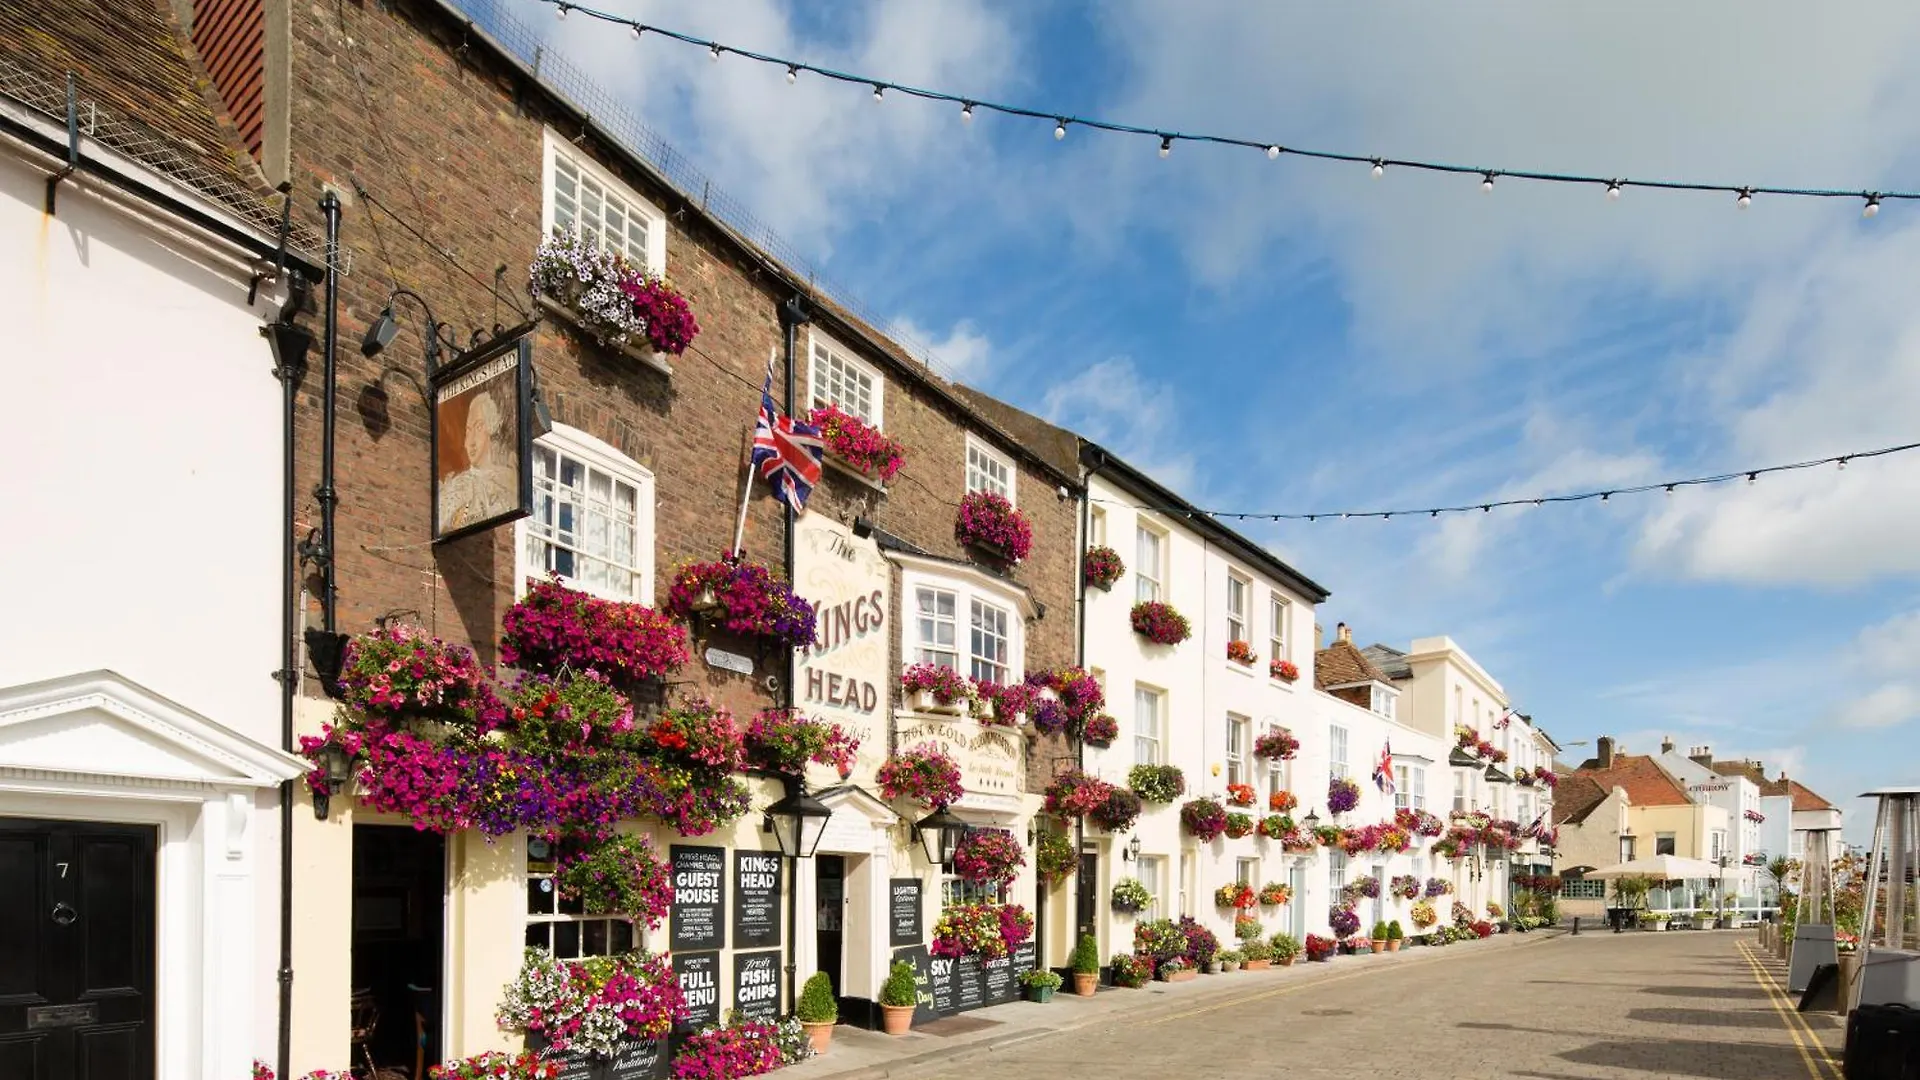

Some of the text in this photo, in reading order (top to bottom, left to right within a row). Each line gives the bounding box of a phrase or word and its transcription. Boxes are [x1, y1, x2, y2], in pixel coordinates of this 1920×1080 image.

[828, 529, 857, 563] The
[804, 666, 878, 714] HEAD
[56, 862, 69, 879] 7
[740, 856, 779, 873] KINGS
[676, 872, 720, 888] GUEST
[740, 873, 776, 889] HEAD
[675, 888, 719, 904] HOUSE
[931, 958, 955, 976] SKY
[679, 970, 714, 990] FULL
[740, 968, 770, 986] FISH
[738, 984, 776, 1003] CHIPS
[916, 989, 934, 1010] Day
